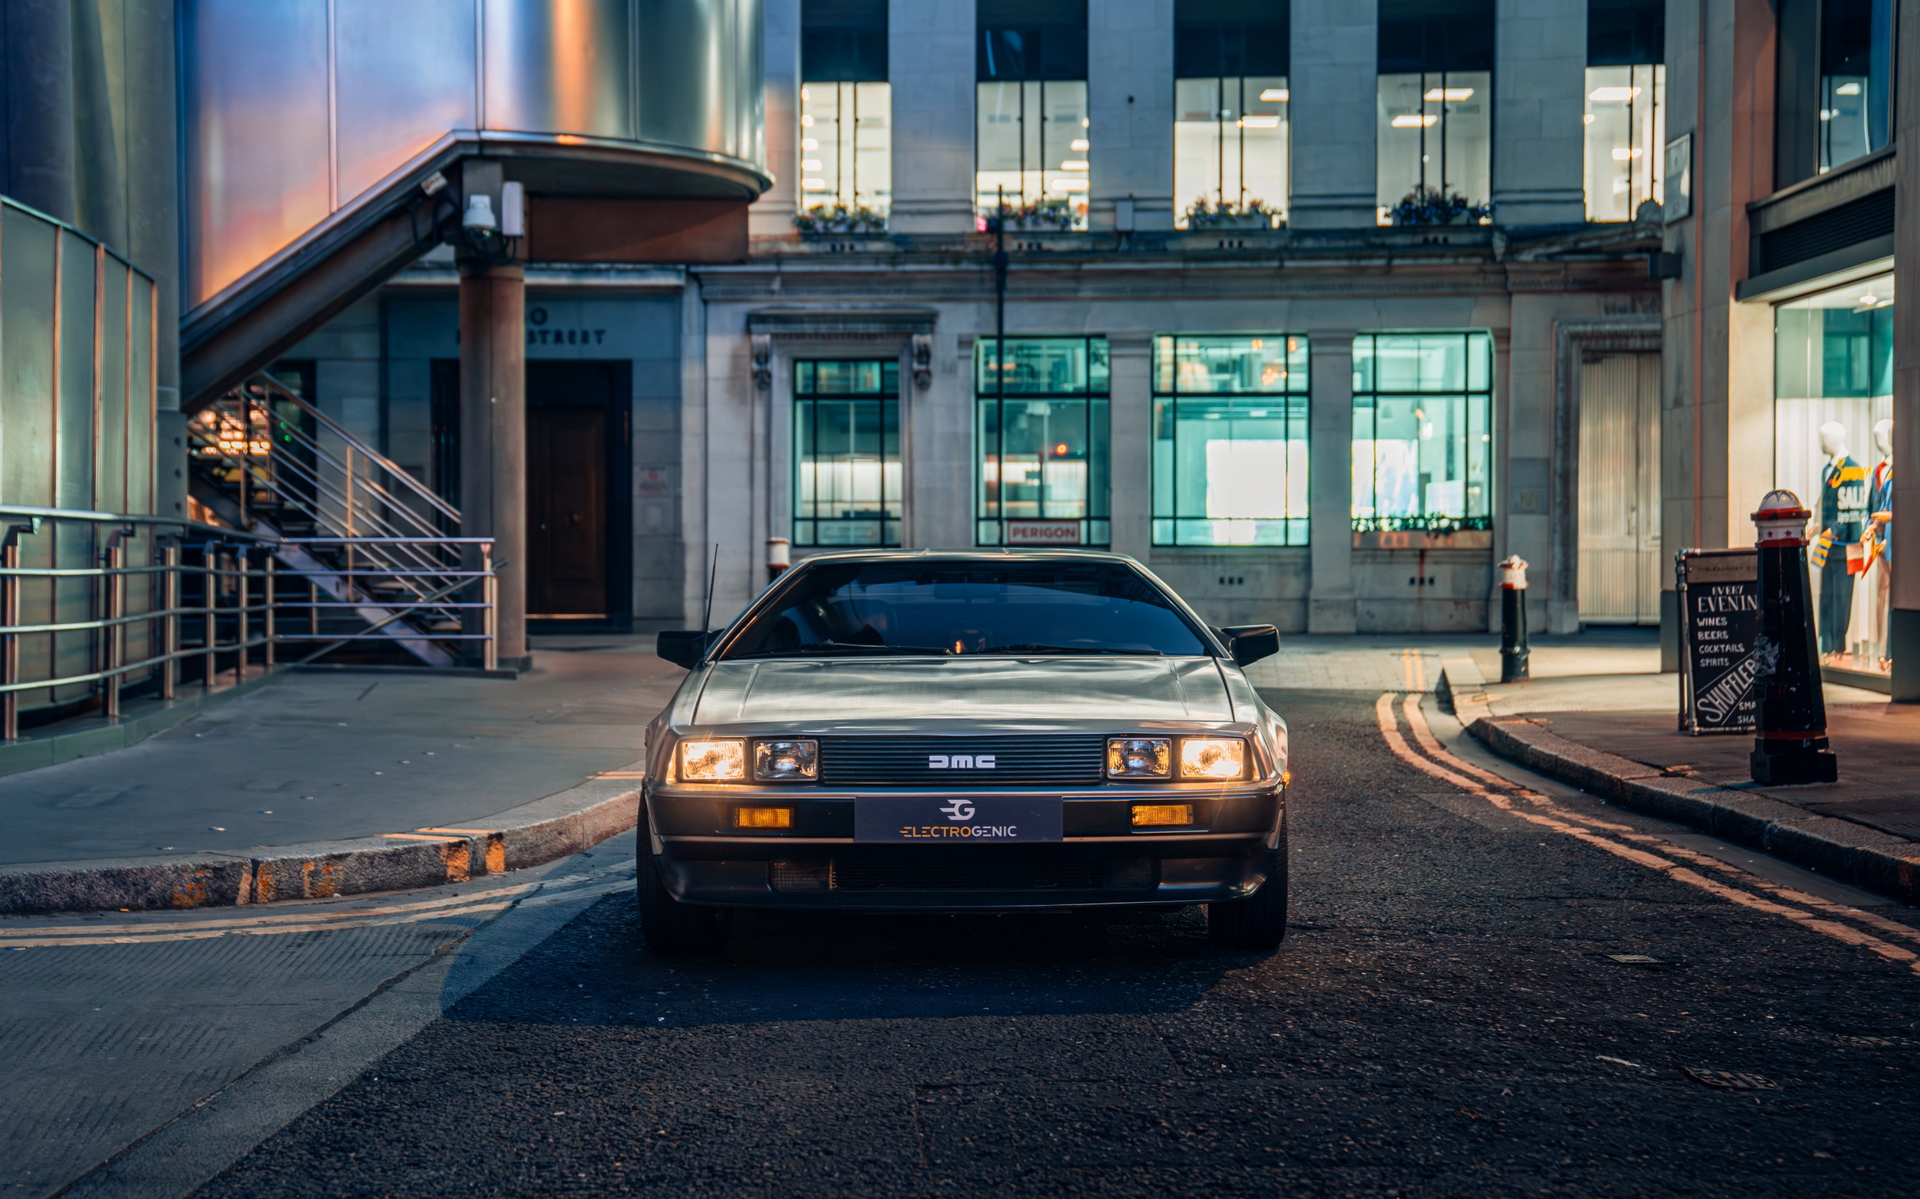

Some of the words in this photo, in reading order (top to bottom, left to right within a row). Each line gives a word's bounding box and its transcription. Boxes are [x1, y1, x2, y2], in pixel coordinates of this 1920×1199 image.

[527, 329, 606, 345] STREET
[1012, 527, 1076, 539] PERIGON
[1712, 585, 1744, 595] EVERY
[1698, 595, 1758, 613] EVENIN
[1697, 617, 1728, 627] WINES
[1698, 630, 1729, 640] BEERS
[1699, 643, 1745, 654] COCKTAILS
[1700, 658, 1730, 667] SPIRITS
[1738, 701, 1756, 711] SMA
[1737, 715, 1756, 724] SHA
[899, 825, 1018, 838] ELECTROGENIC
